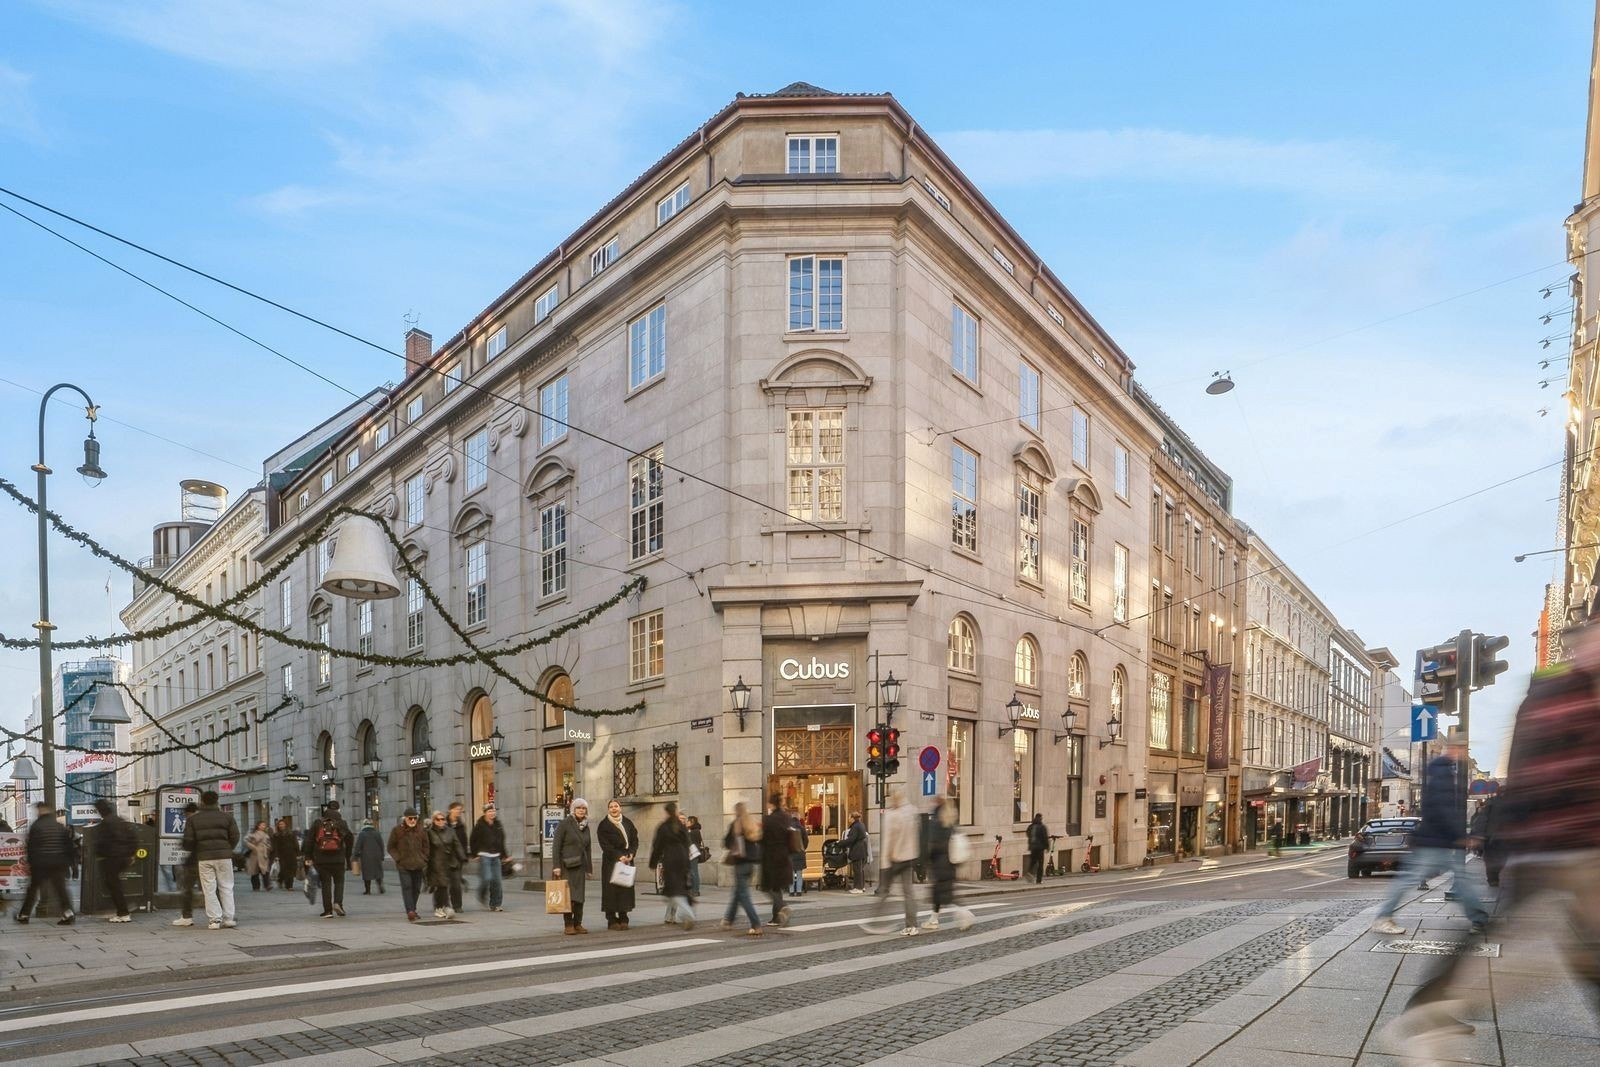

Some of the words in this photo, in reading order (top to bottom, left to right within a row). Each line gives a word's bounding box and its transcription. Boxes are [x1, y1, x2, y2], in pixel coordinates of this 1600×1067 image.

[780, 656, 850, 680] Cubus
[568, 729, 591, 739] Cubus
[470, 743, 492, 757] Cubus
[167, 794, 194, 804] Sone
